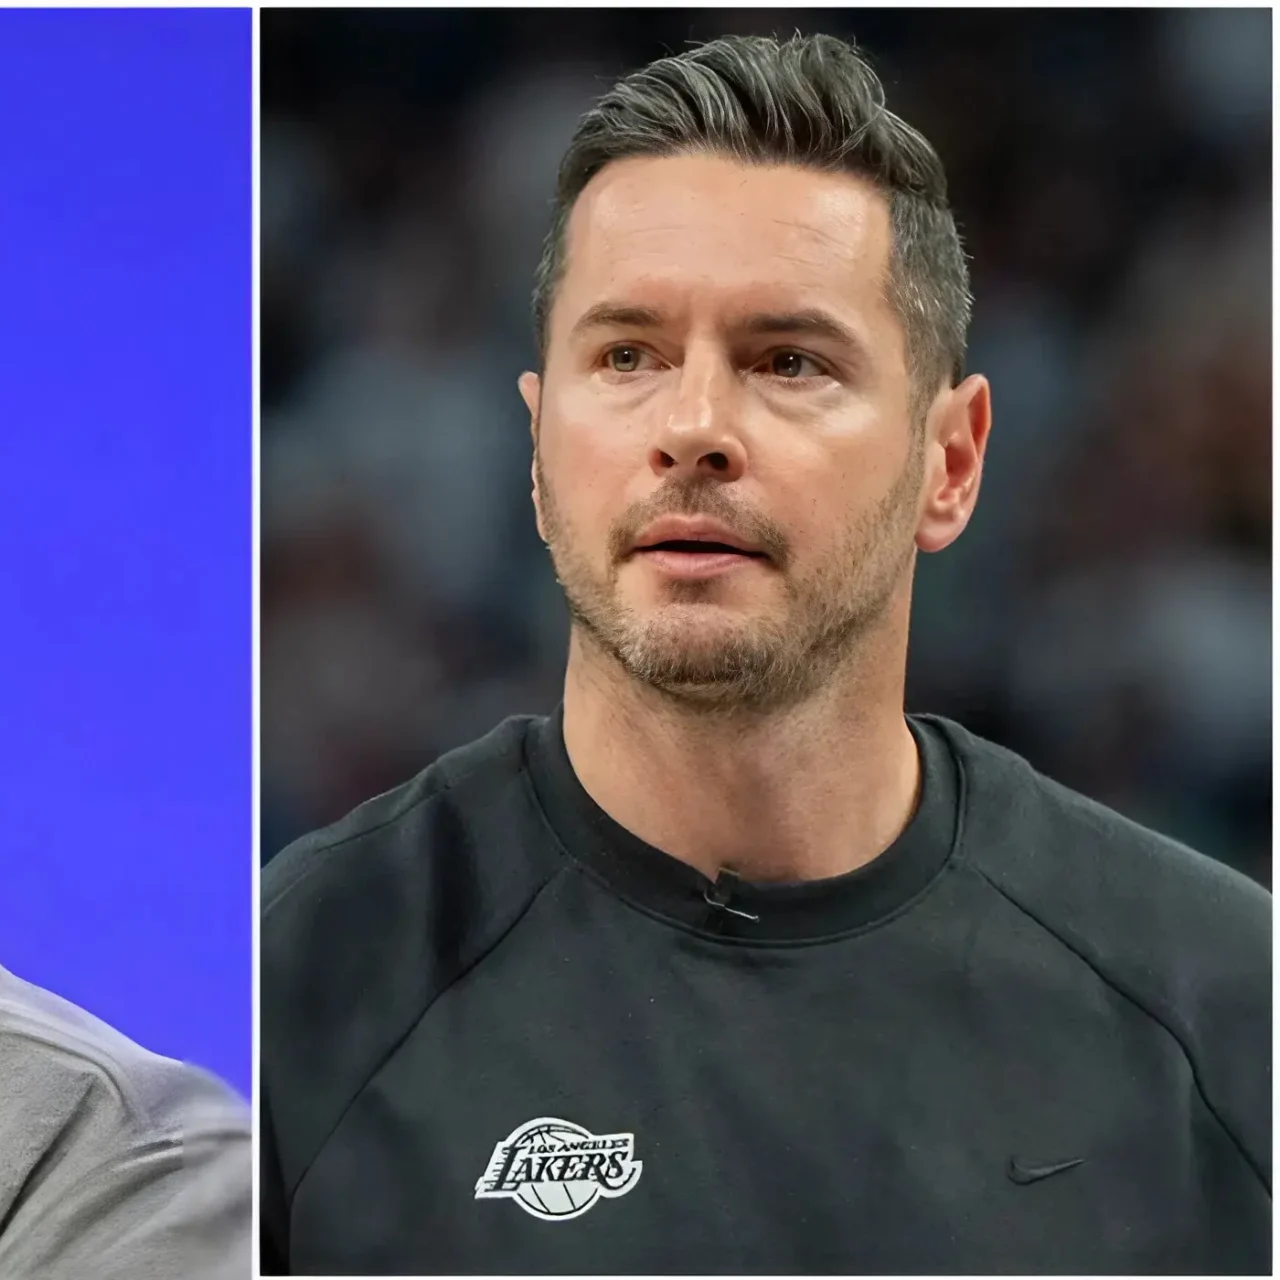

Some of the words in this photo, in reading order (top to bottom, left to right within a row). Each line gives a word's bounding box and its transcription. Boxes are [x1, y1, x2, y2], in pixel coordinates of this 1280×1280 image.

[528, 1144, 556, 1155] LOS
[557, 1138, 630, 1152] ANGELES
[483, 1145, 637, 1192] LAKERS
